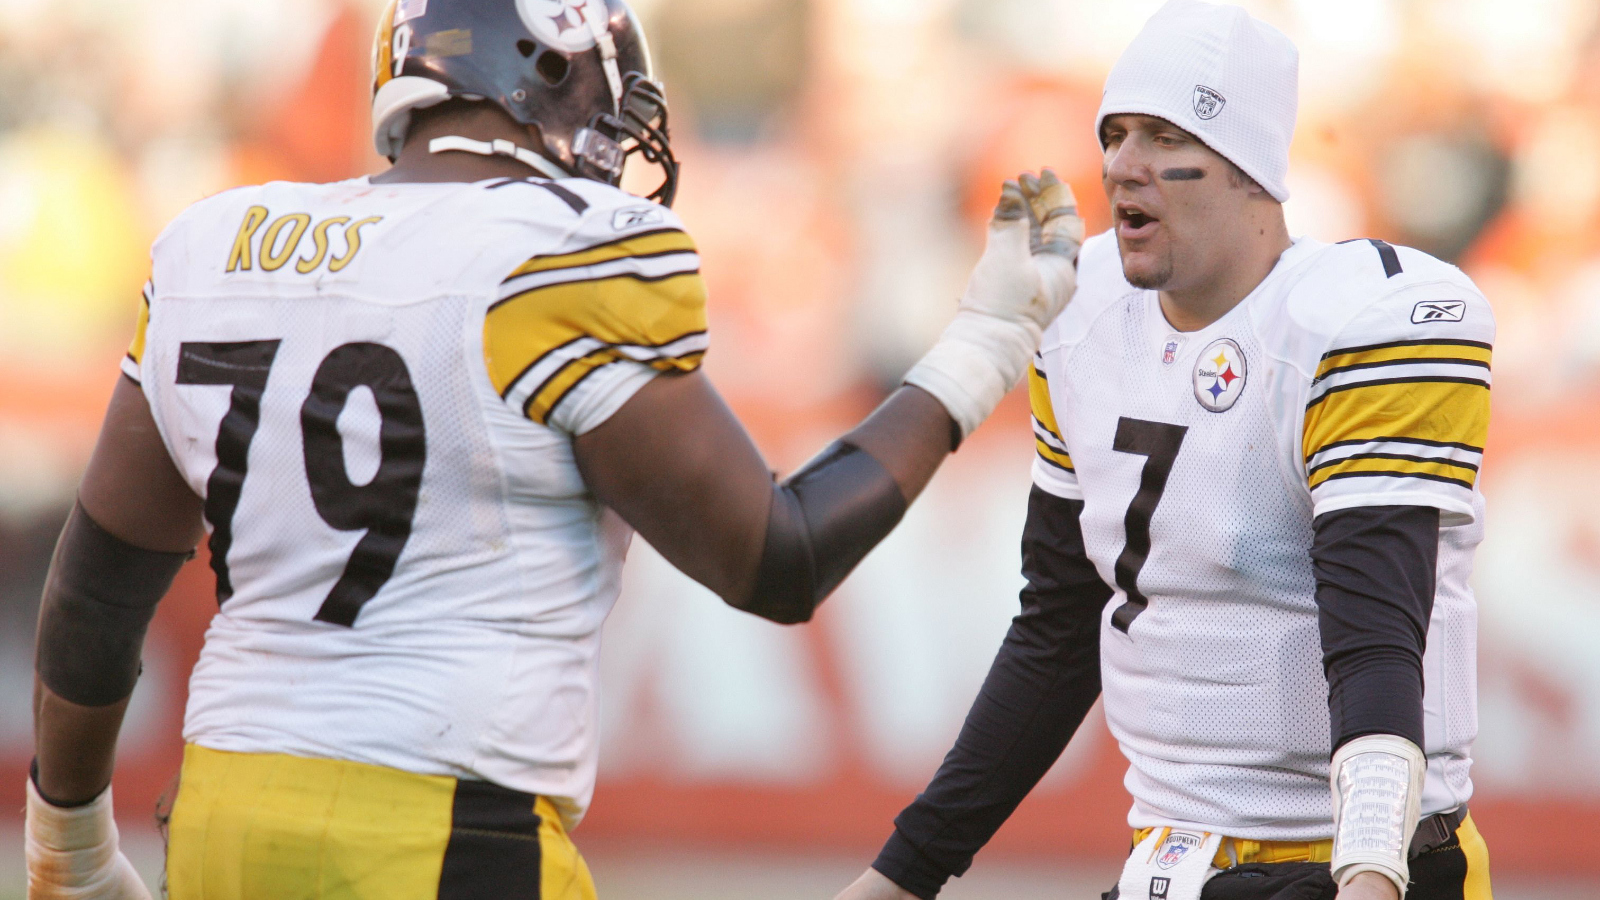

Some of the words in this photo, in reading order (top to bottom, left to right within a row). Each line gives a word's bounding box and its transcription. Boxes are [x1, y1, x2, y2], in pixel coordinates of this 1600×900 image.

[225, 205, 384, 274] ROSS
[1198, 368, 1218, 378] Steelers
[175, 338, 427, 629] 79
[1111, 416, 1189, 635] 7
[1166, 835, 1198, 846] EQUIPMENT
